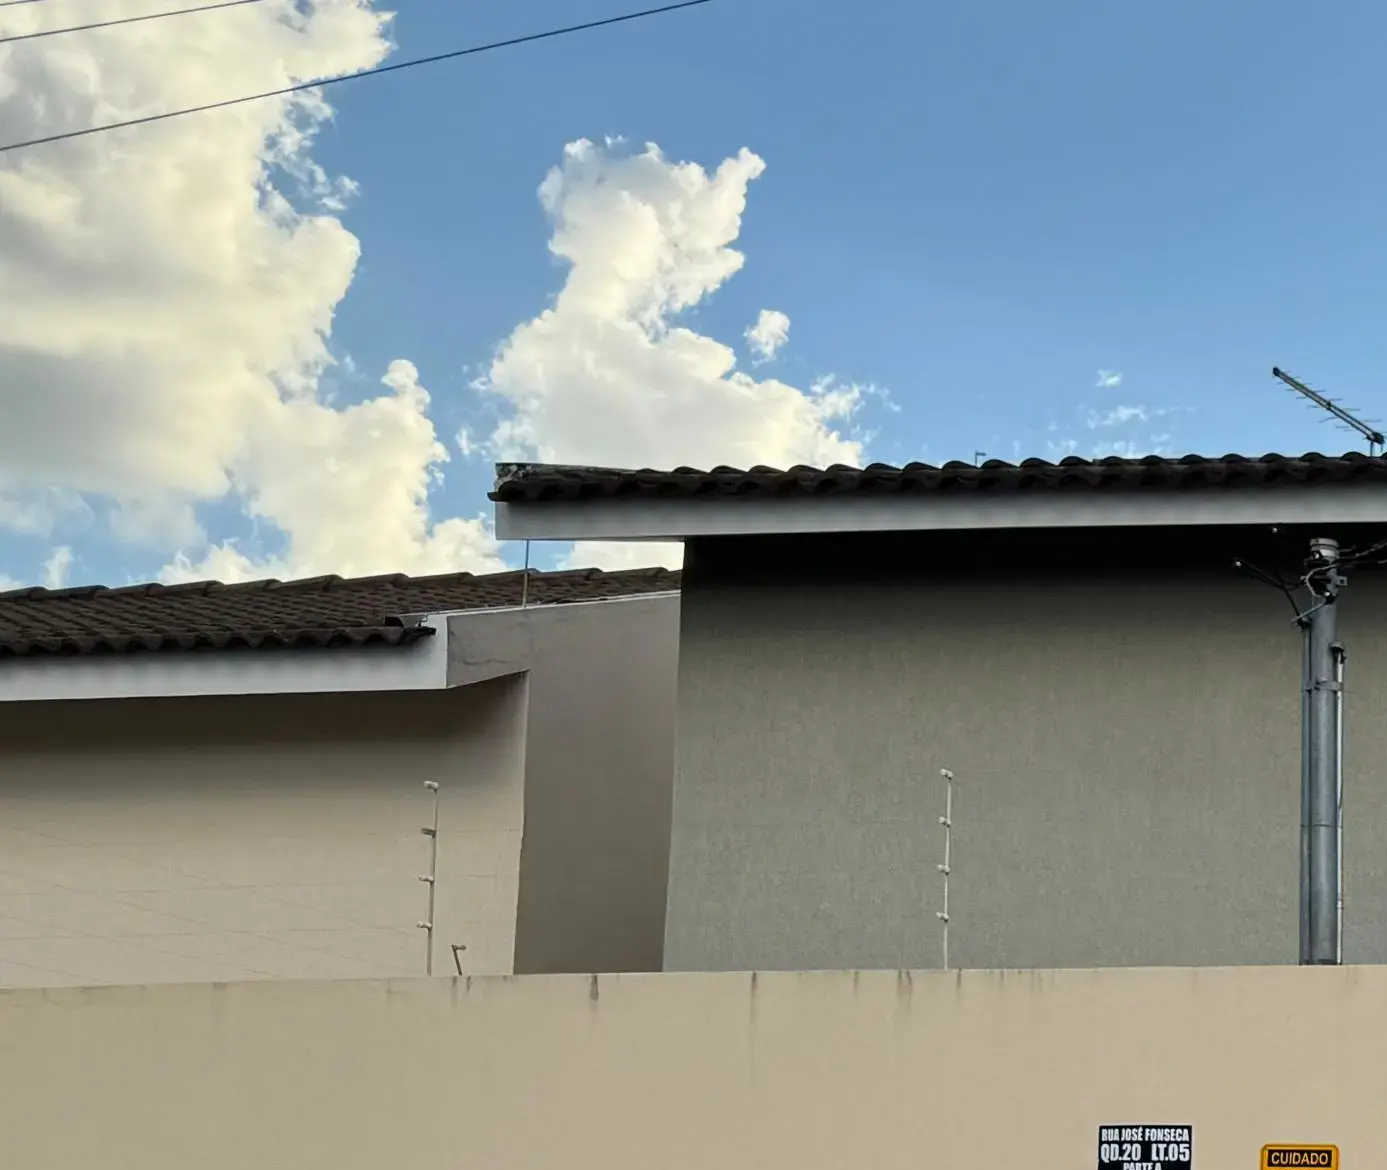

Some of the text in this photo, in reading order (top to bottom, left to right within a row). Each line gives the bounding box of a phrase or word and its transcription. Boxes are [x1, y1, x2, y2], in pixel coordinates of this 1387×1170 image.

[1101, 1126, 1190, 1142] RUA JOSÉ FONSECA
[1100, 1143, 1190, 1162] QD.20 LT.05
[1271, 1152, 1329, 1165] CUIDADO
